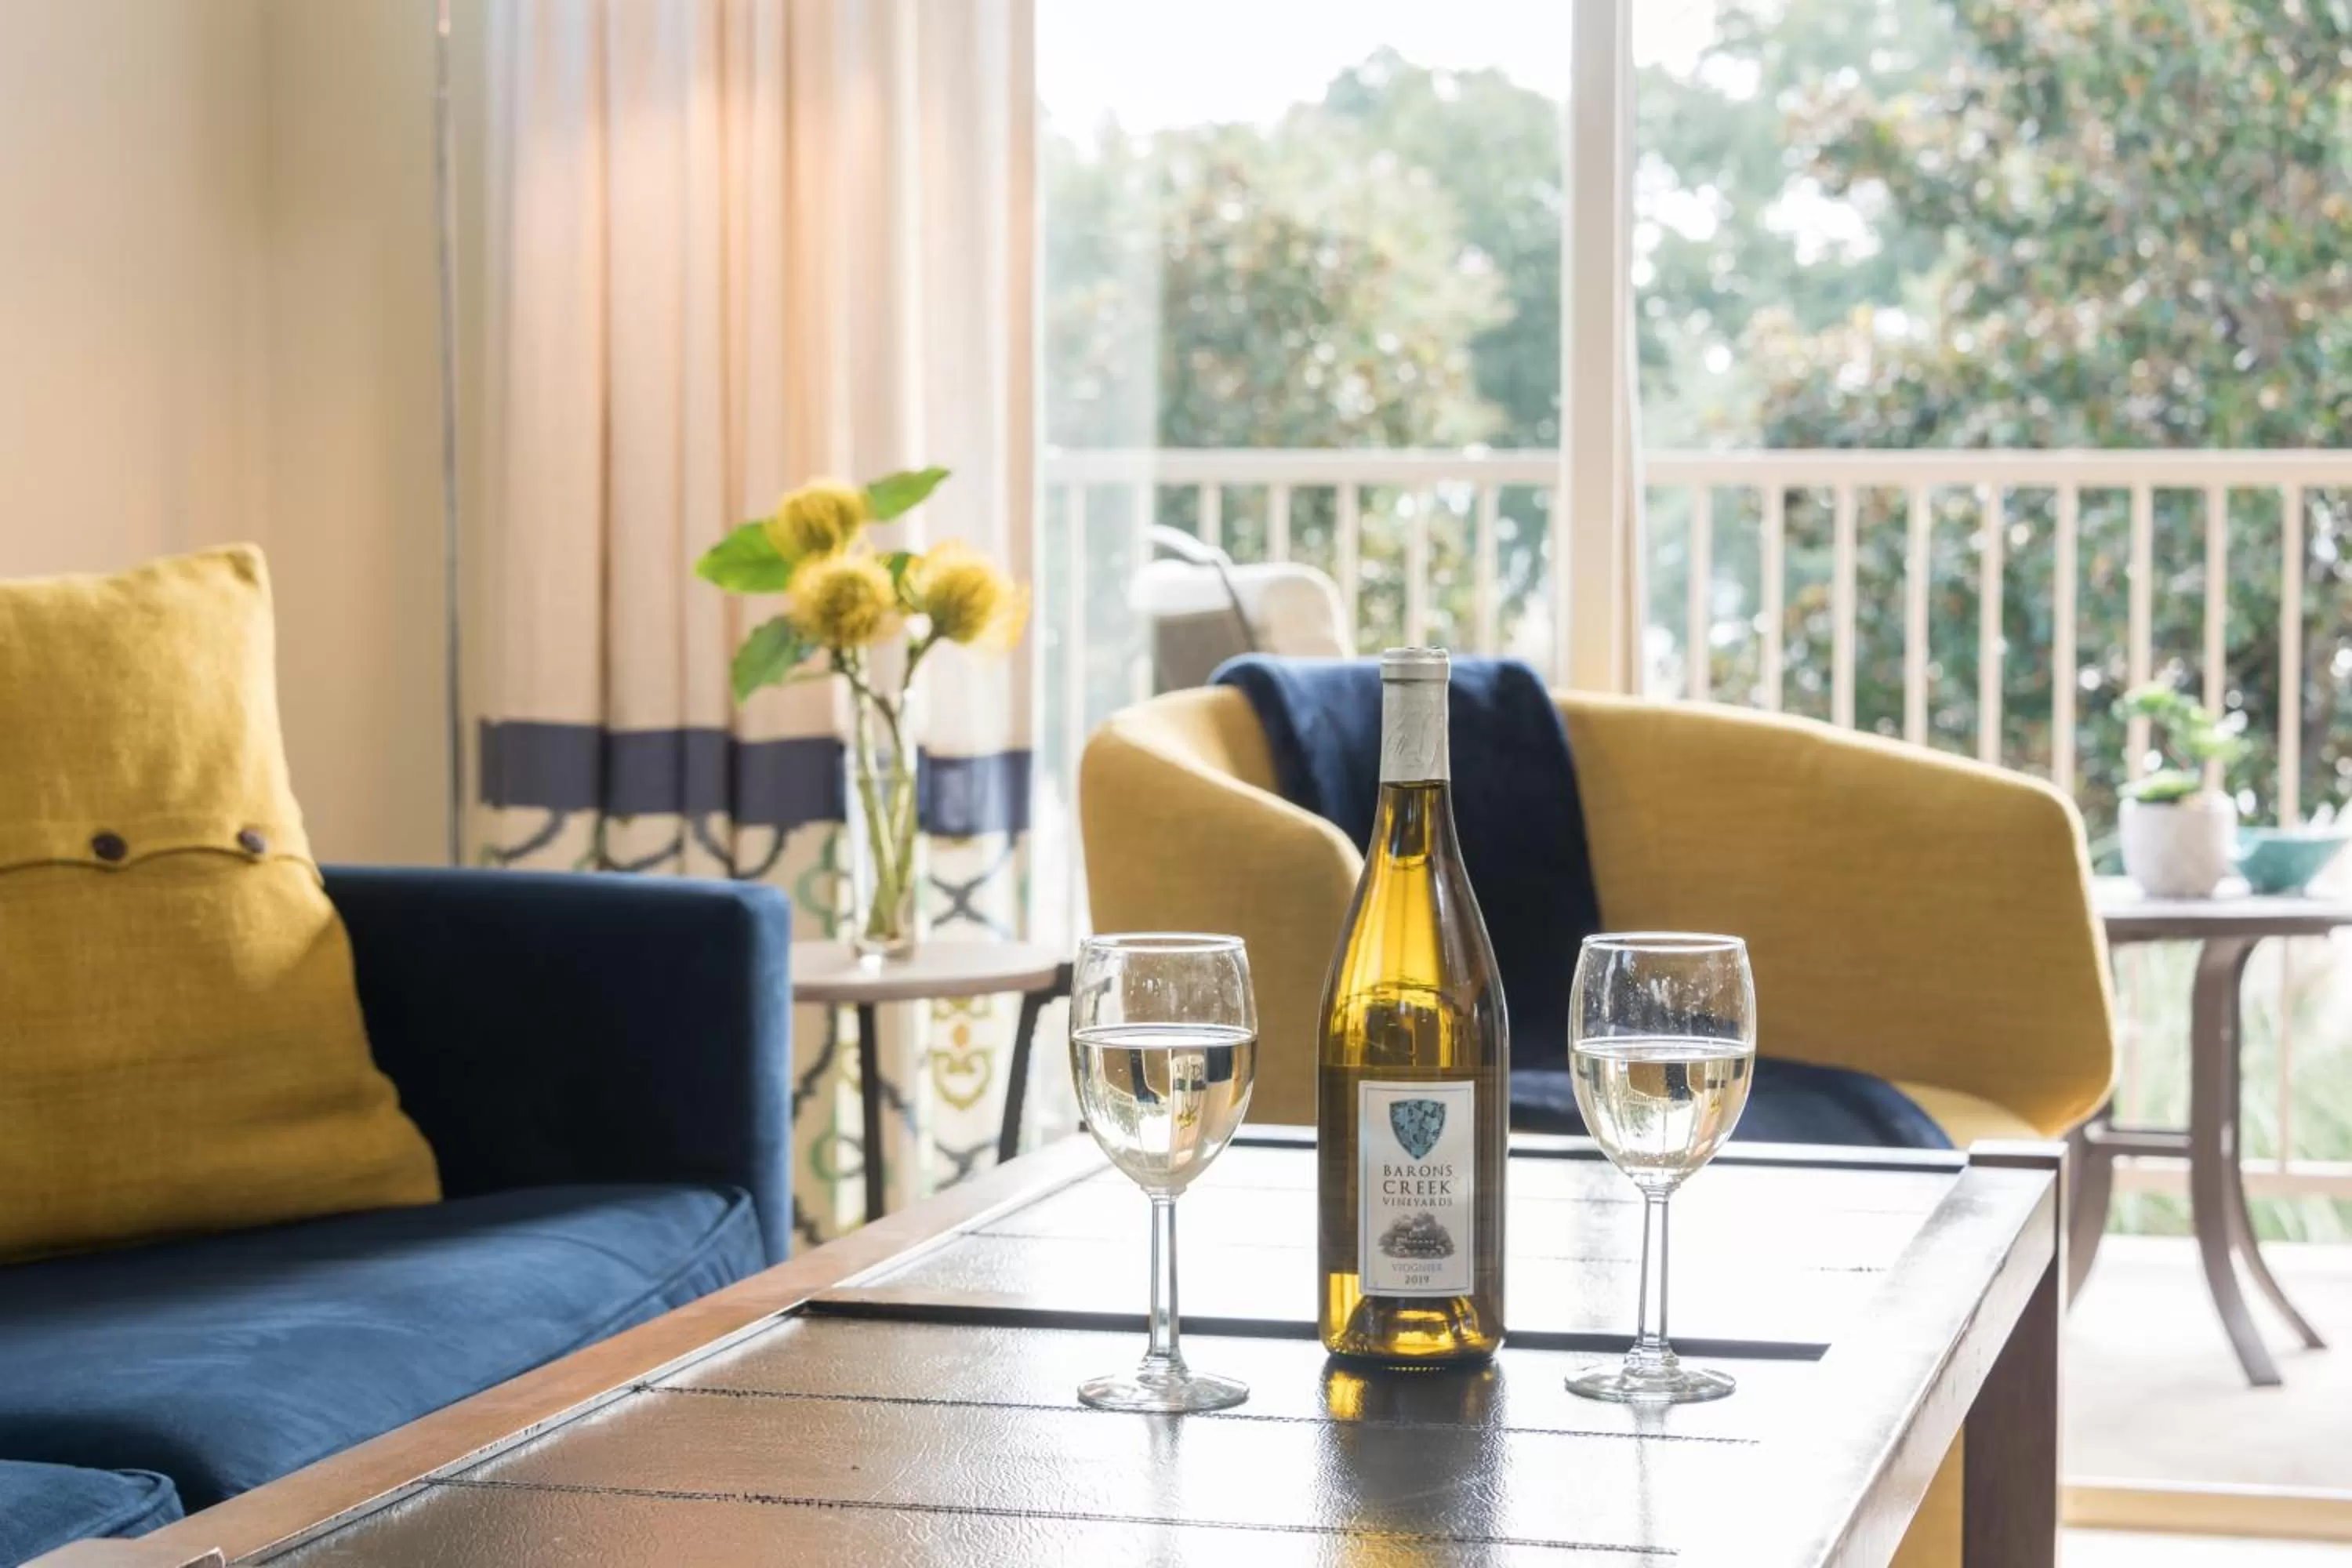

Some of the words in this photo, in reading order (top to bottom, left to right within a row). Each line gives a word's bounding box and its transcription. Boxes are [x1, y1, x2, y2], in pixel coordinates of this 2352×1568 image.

[1383, 1164, 1453, 1177] BARONS
[1382, 1180, 1451, 1195] CREEK
[1382, 1197, 1453, 1207] VINEYARDS
[1392, 1263, 1443, 1272] VIOGNIER
[1404, 1275, 1430, 1284] 2019
